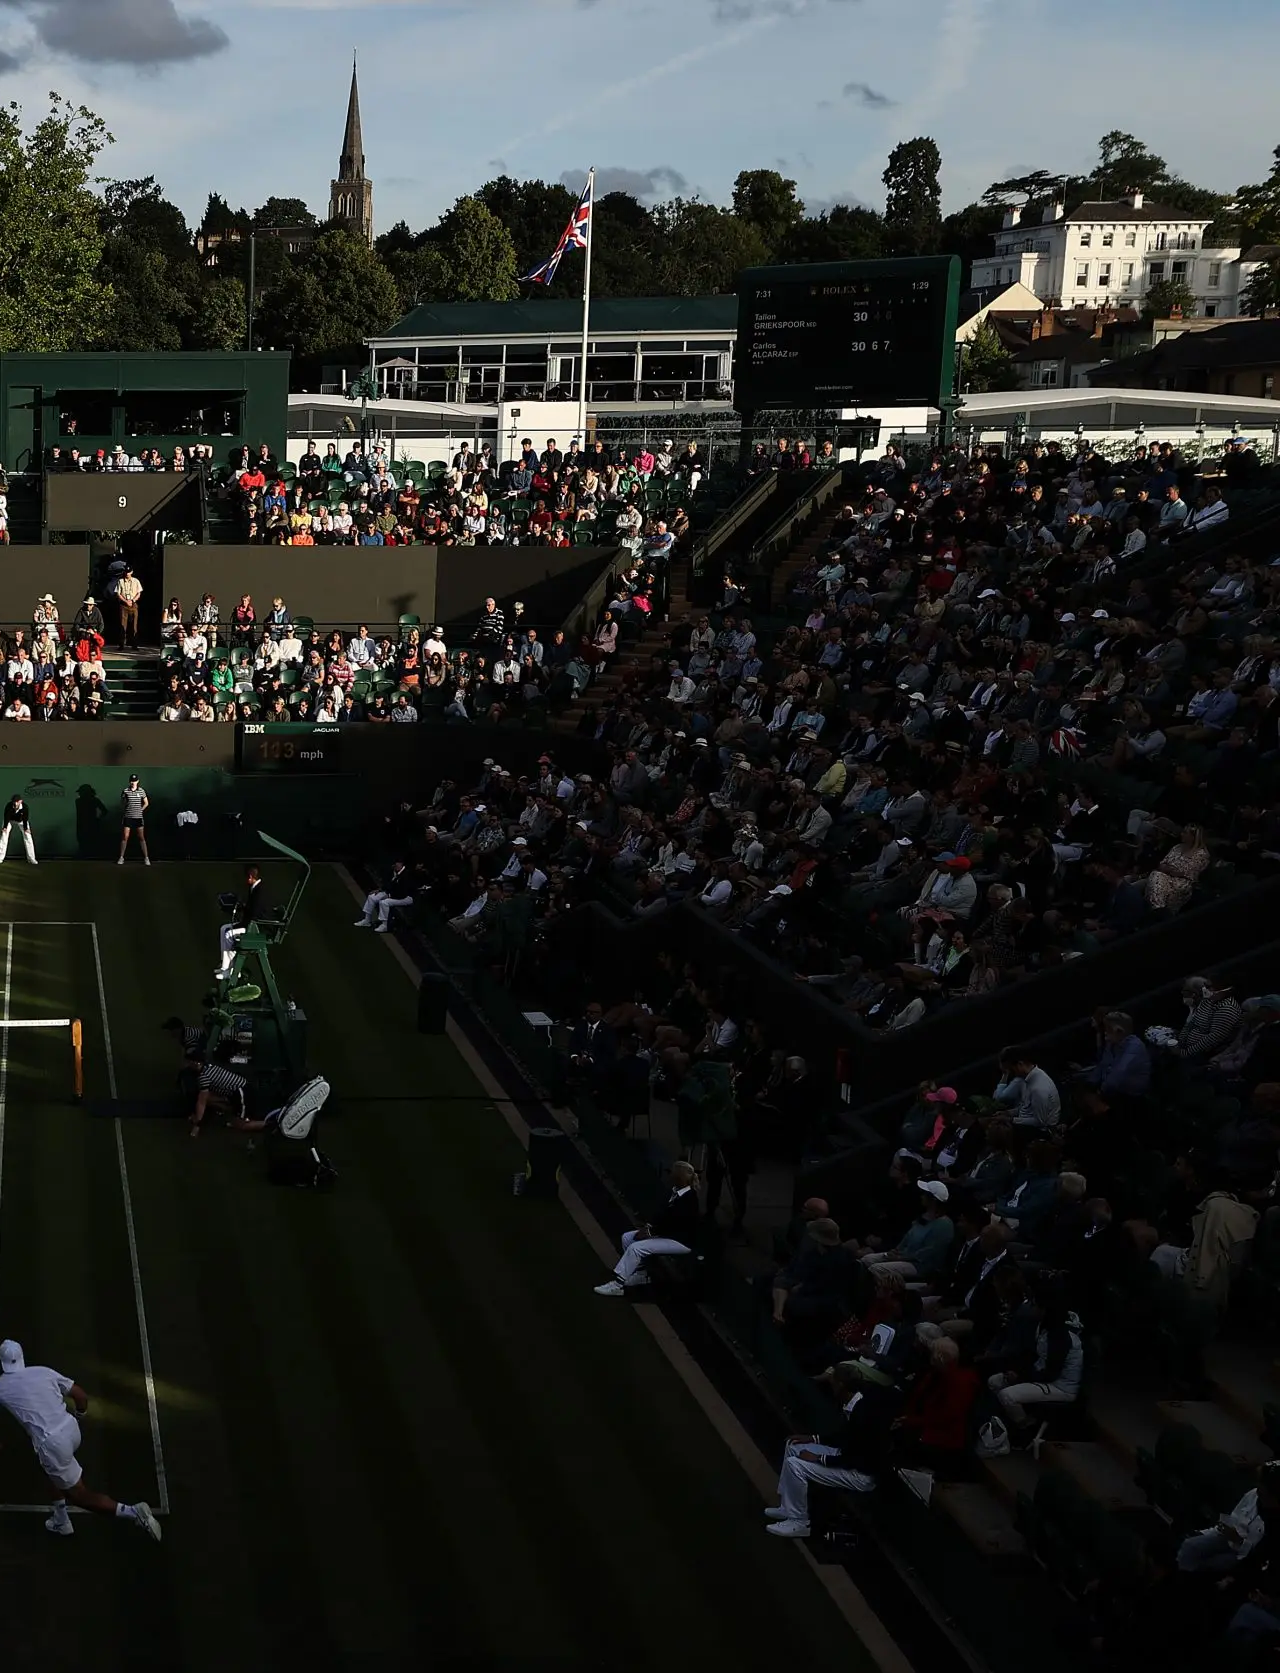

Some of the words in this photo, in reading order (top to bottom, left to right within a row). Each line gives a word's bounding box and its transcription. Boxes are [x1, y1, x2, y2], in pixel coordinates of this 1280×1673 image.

[823, 286, 857, 295] ROLEX
[912, 282, 929, 291] 1:29
[853, 312, 868, 322] 30
[754, 321, 806, 330] GRIEKSPOOR
[851, 342, 866, 351] 30
[872, 341, 879, 350] 6
[884, 341, 890, 350] 7
[752, 351, 788, 359] ALCARAZ
[118, 496, 126, 508] 9
[244, 725, 265, 734] IBM
[300, 750, 324, 760] mph
